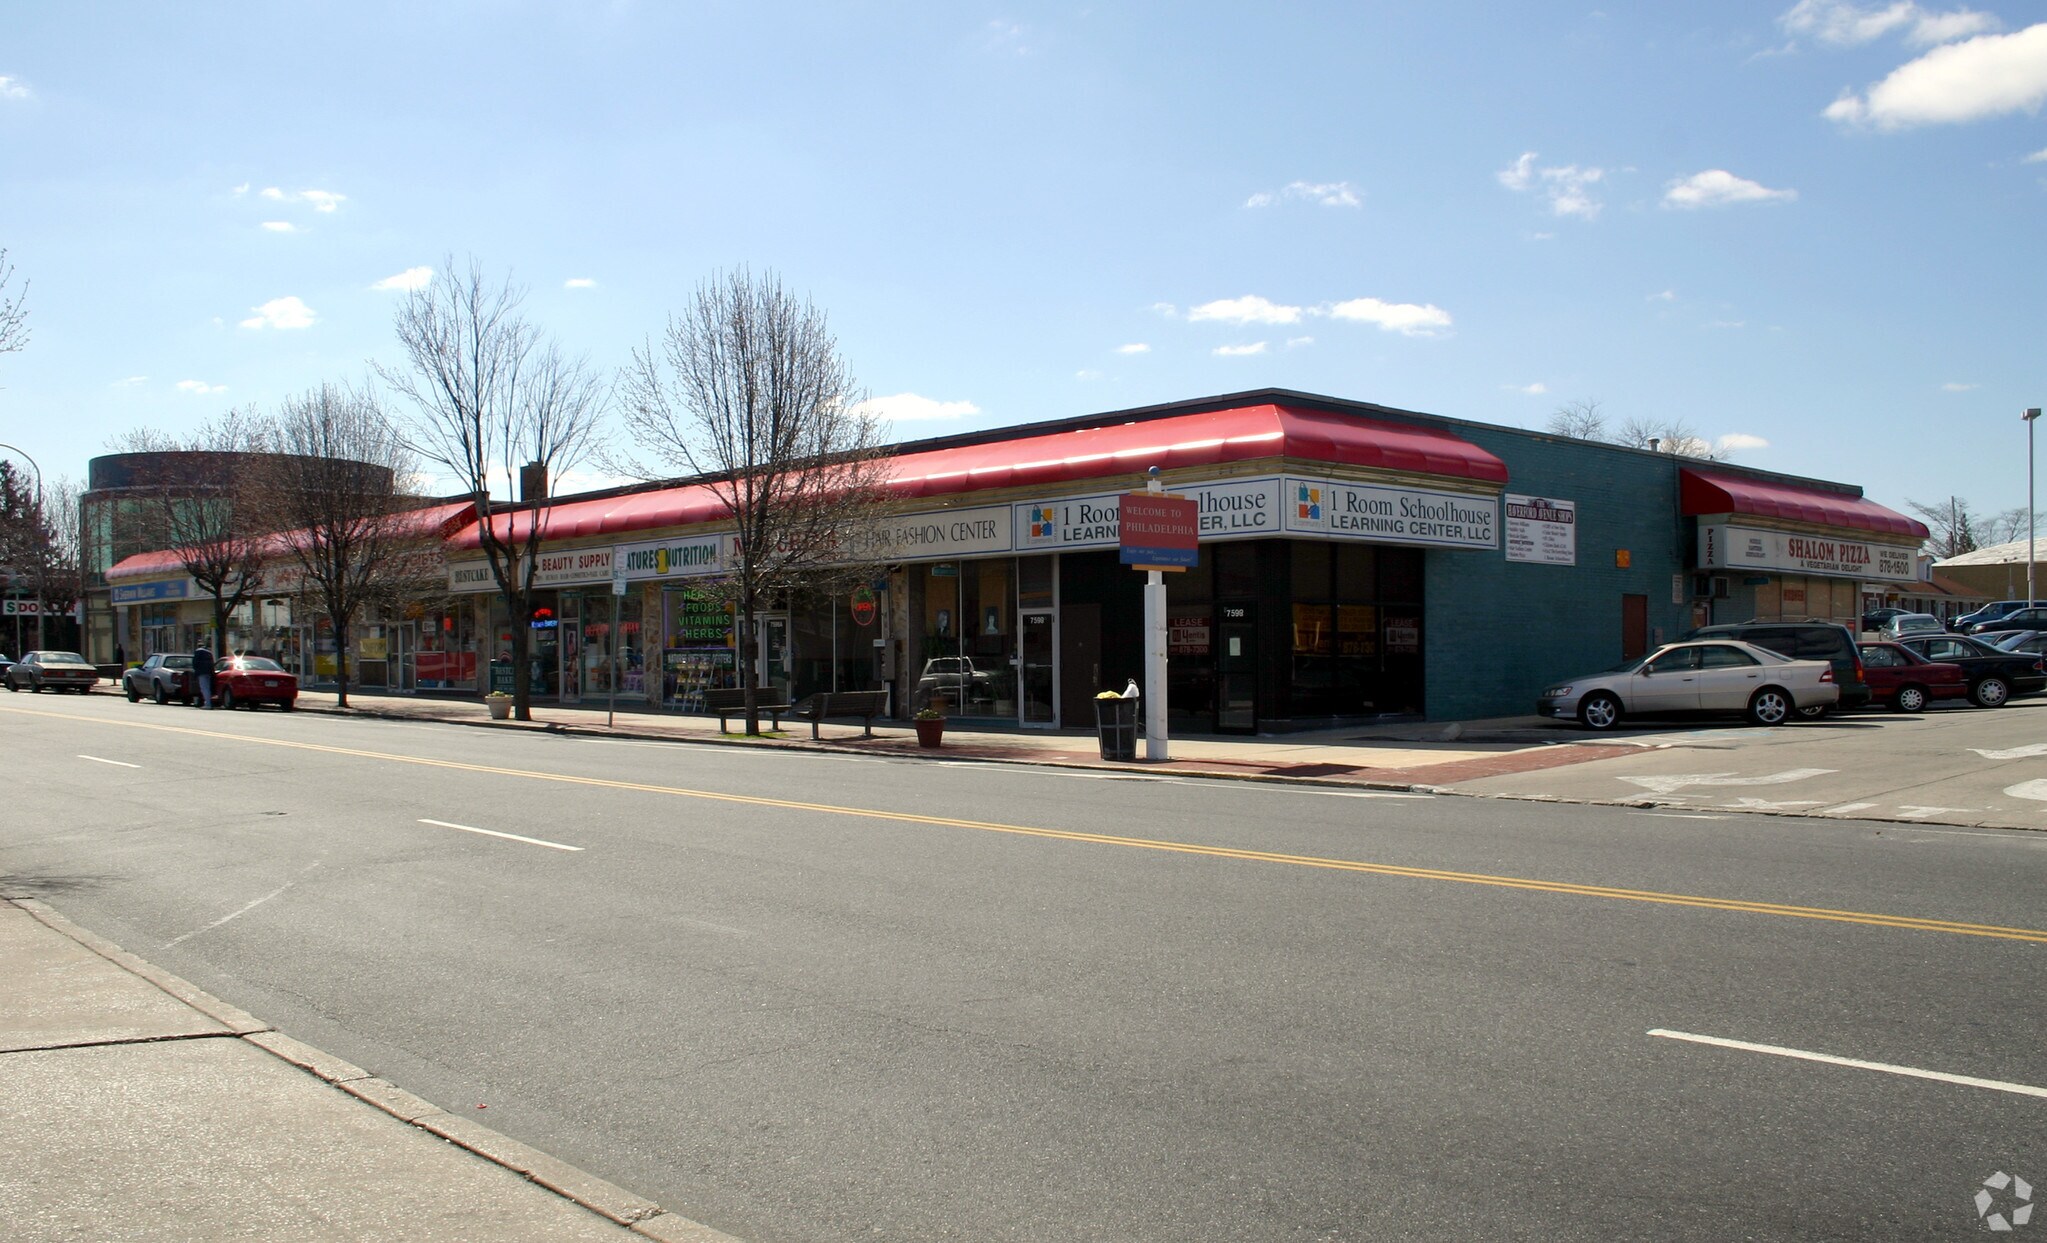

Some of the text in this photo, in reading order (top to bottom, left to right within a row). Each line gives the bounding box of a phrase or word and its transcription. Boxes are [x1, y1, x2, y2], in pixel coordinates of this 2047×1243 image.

[1199, 492, 1266, 513] lhouse
[1331, 490, 1337, 511] 1
[1346, 491, 1393, 516] Room
[1400, 497, 1491, 525] Schoolhouse
[1064, 506, 1070, 525] 1
[1125, 506, 1182, 517] WELCOME TO
[1558, 510, 1573, 523] SHOPS
[1231, 512, 1266, 528] LLC
[1331, 515, 1404, 533] LEARNING
[1409, 521, 1465, 540] CENTER,
[1467, 525, 1491, 540] LLC
[896, 525, 945, 546] FASHION
[950, 520, 997, 541] CENTER
[1126, 522, 1194, 535] PHILADELPHIA
[626, 549, 659, 571] ATURES
[665, 543, 717, 568] NUTRITION
[1788, 538, 1871, 564] SHALOM PIZZA
[1889, 552, 1909, 560] DELIVER
[542, 552, 611, 571] BEAUTY SUPPLY
[1807, 561, 1839, 571] VEGETARIAN
[1841, 564, 1862, 573] DELIGHT
[1879, 560, 1910, 575] 878-1500
[454, 568, 489, 583] BESTCAKE
[678, 614, 730, 626] VITAMINS
[1226, 608, 1244, 617] 7598
[1174, 618, 1203, 626] LEASE
[685, 628, 723, 639] HERBS
